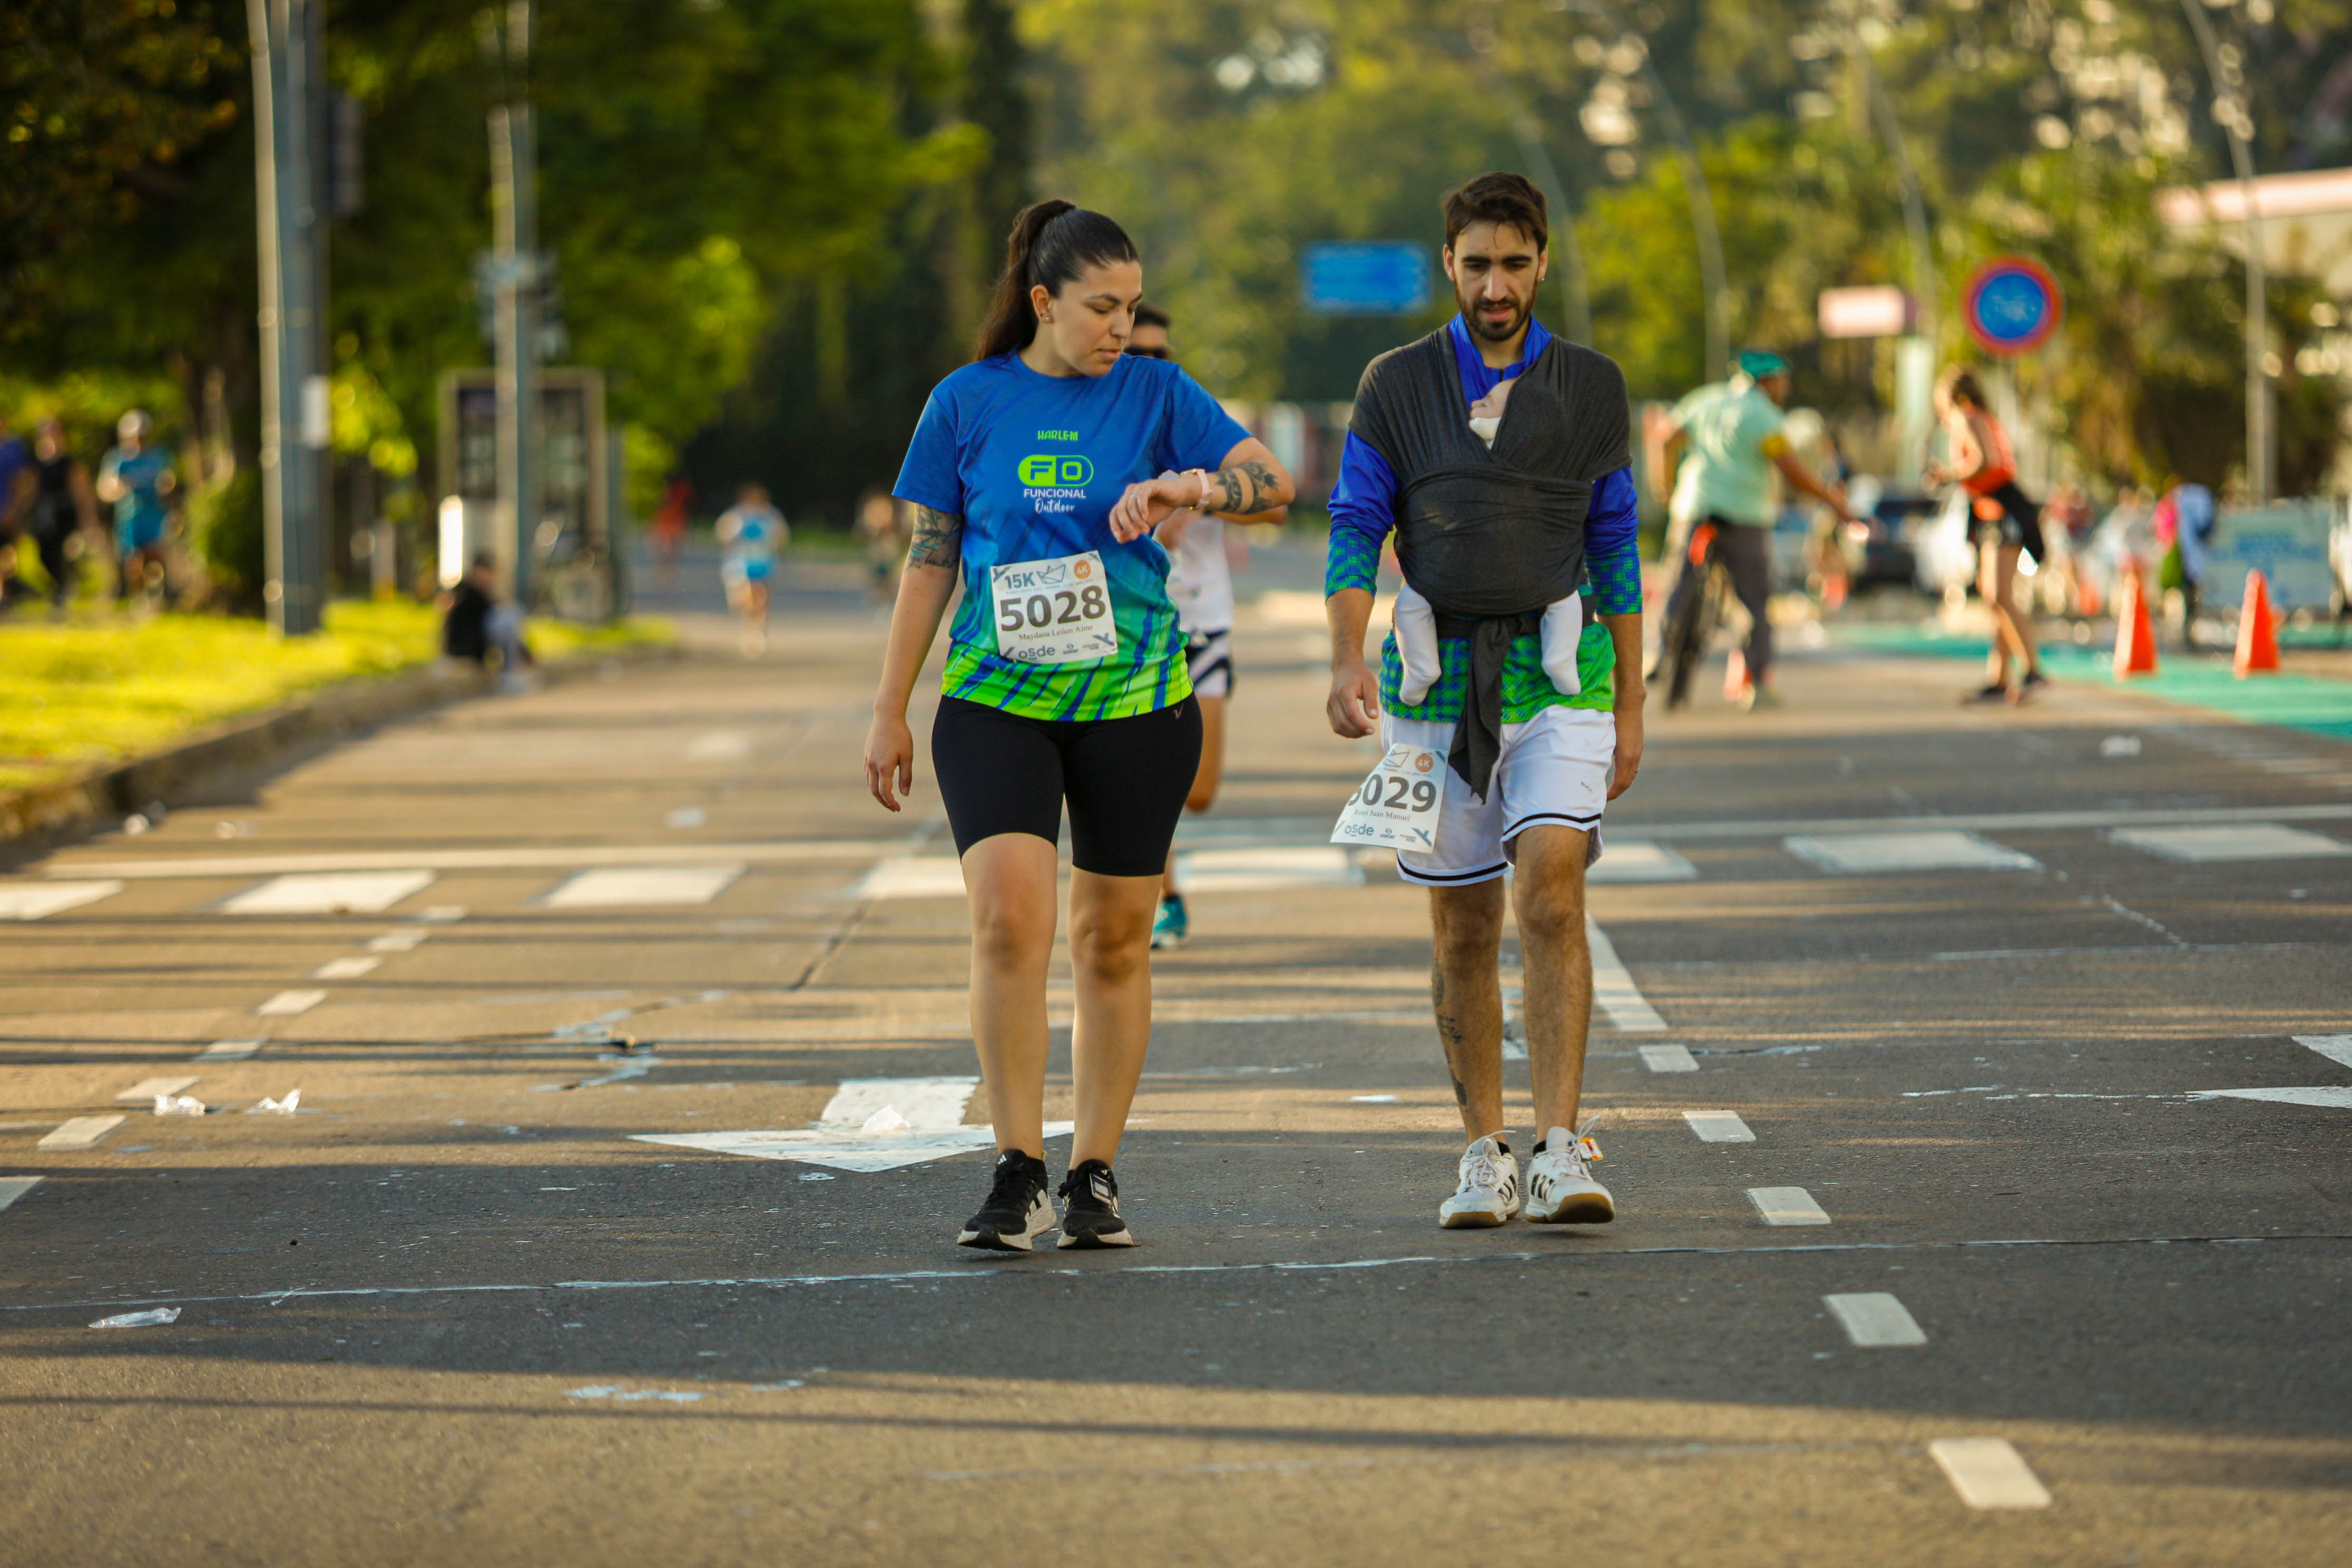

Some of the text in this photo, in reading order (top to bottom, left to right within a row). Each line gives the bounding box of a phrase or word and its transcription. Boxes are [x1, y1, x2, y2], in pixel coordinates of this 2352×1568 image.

[1037, 430, 1079, 441] HARLEM
[1023, 488, 1086, 498] FUNCIONAL
[1035, 497, 1075, 514] Outdoor
[1077, 565, 1089, 574] 4K
[1004, 572, 1036, 590] 15K
[1000, 585, 1106, 632] 5028
[1018, 632, 1050, 641] Maydana
[1018, 645, 1055, 659] osde
[1418, 759, 1430, 768] 4K
[1369, 810, 1384, 818] Juan
[1386, 811, 1410, 821] Manuel
[1345, 824, 1375, 837] osde
